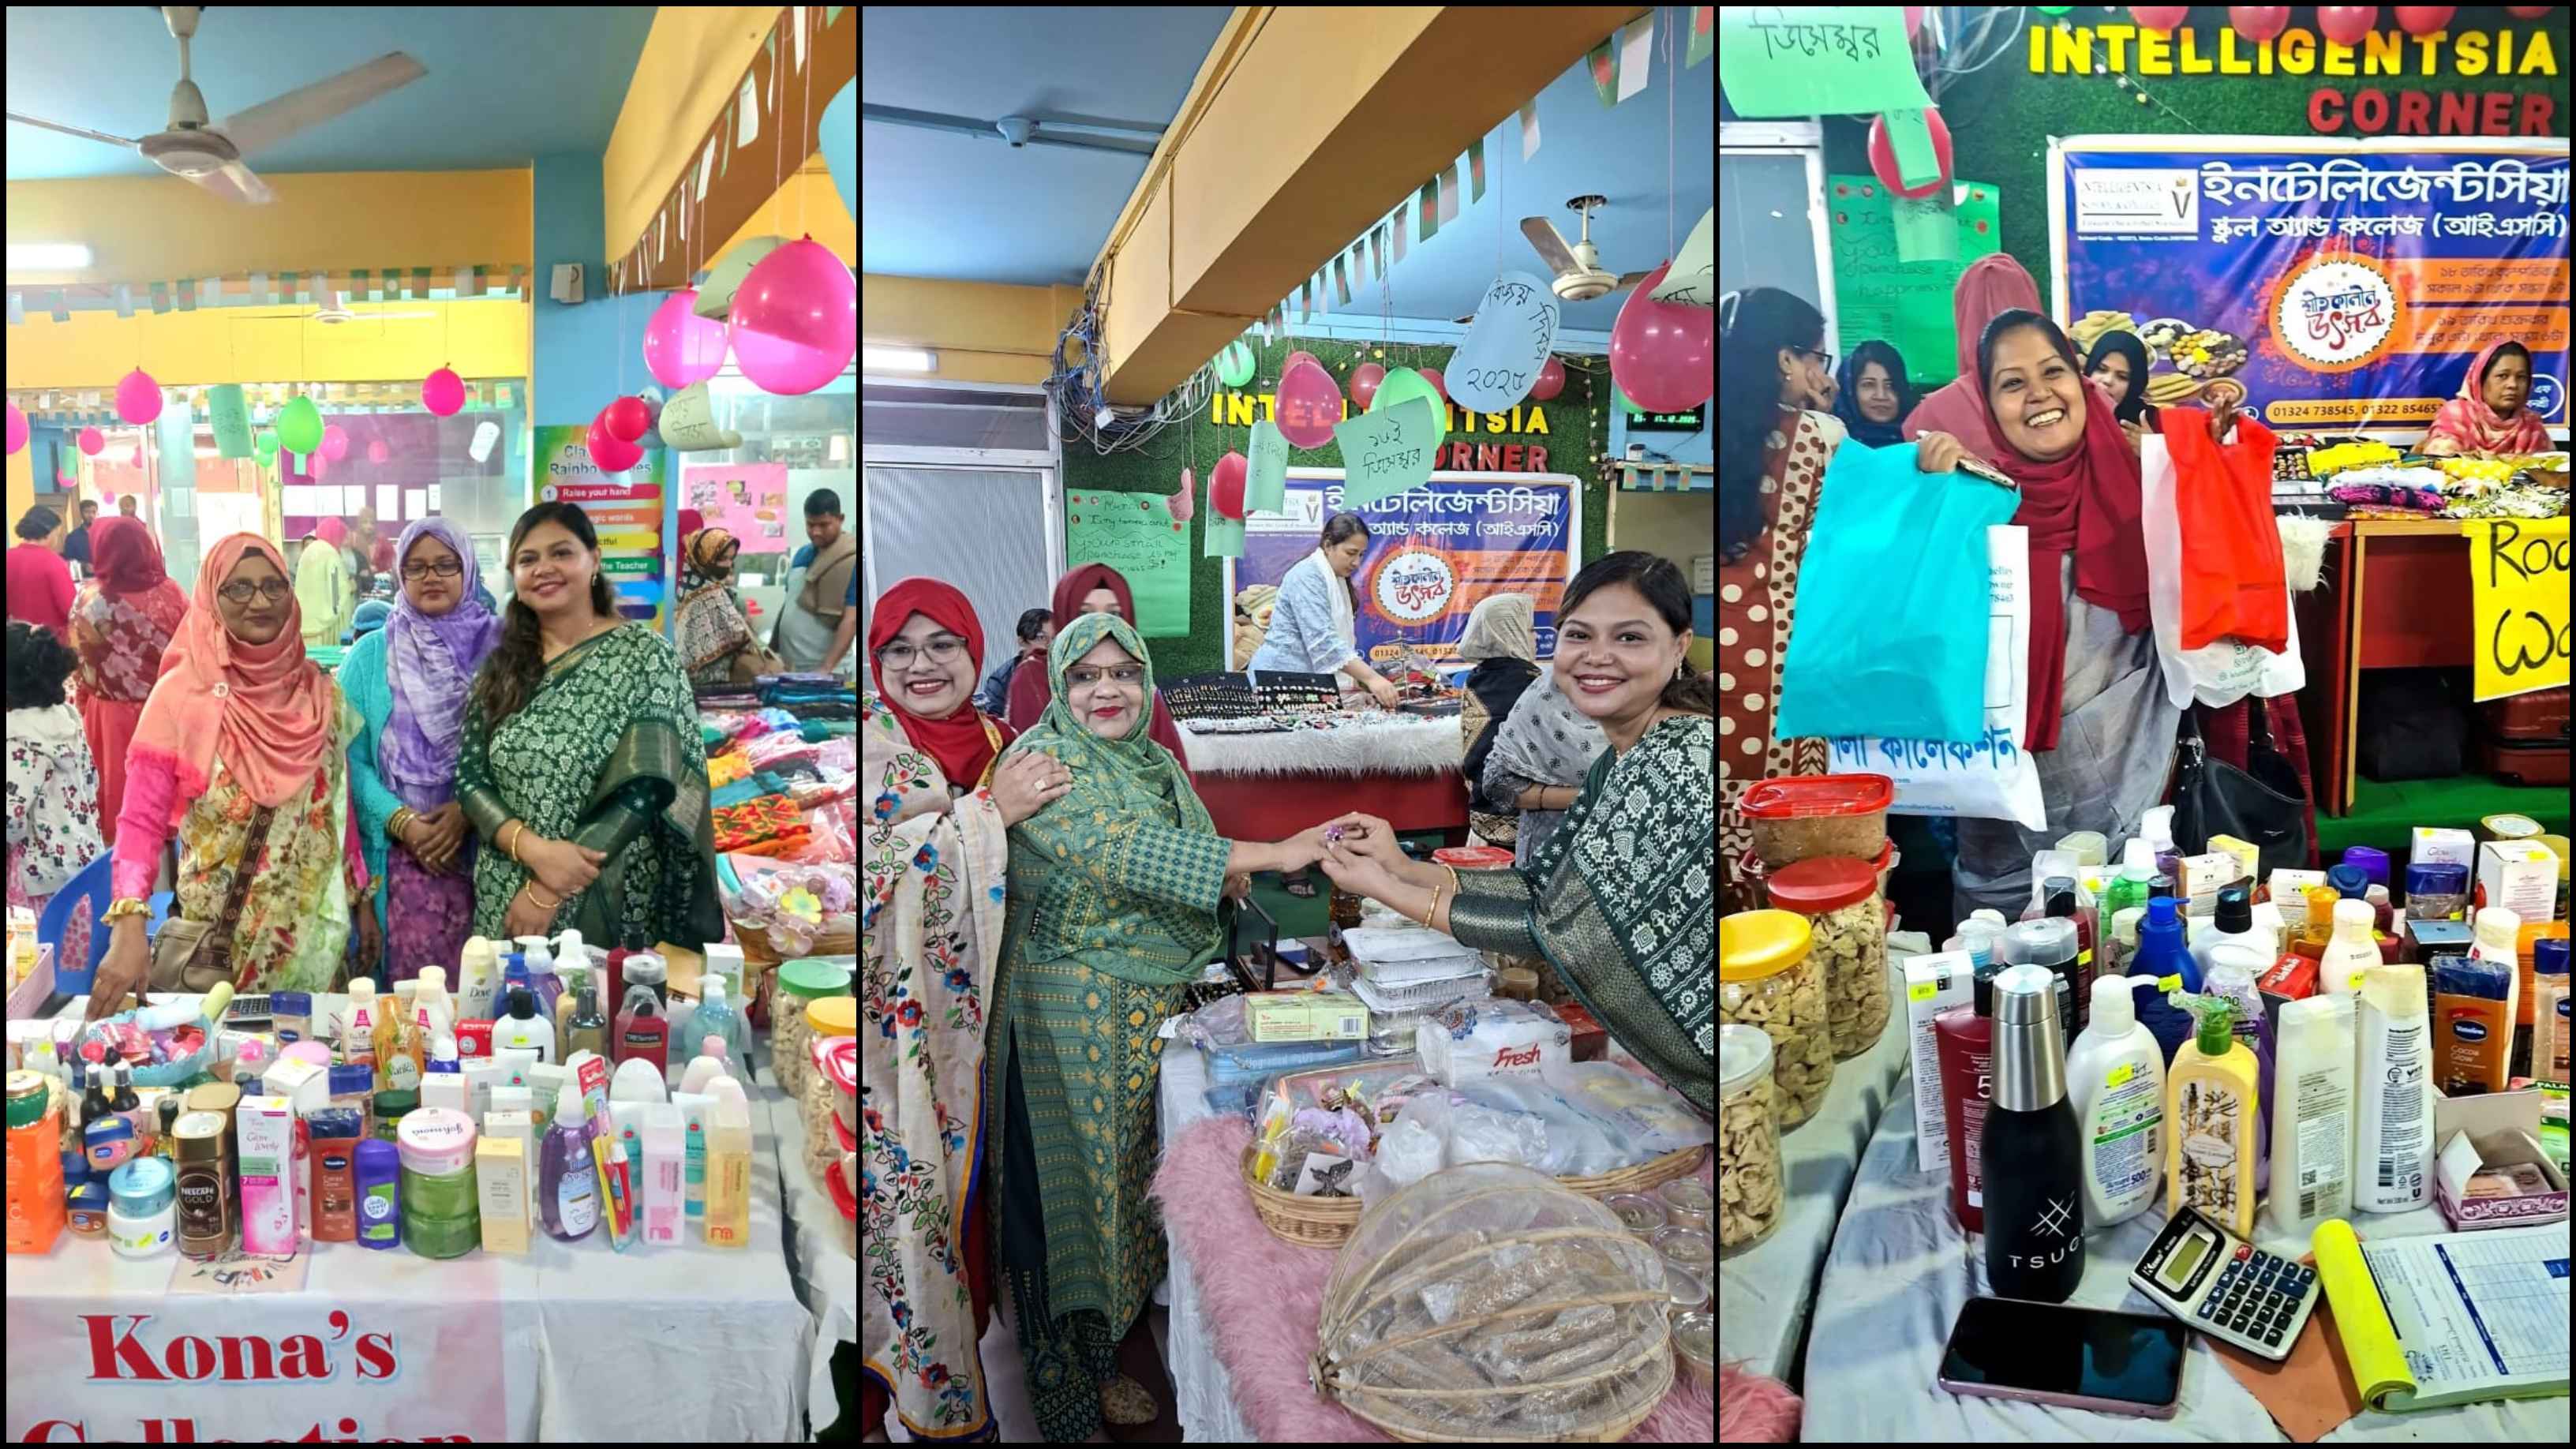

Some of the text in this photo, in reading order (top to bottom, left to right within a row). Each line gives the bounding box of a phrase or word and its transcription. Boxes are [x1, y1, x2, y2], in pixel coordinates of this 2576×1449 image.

[2029, 25, 2558, 76] INTELLIGENTSIA
[2308, 88, 2554, 136] CORNER
[2200, 159, 2569, 207] ইনটেলিজেন্টসিয়া
[2211, 215, 2258, 243] স্কুল
[2338, 216, 2425, 238] কলেজ
[2432, 211, 2567, 238] (আইএসসি)
[2305, 299, 2386, 350] উৎসব
[1466, 368, 1526, 398] ২০২৫
[2273, 406, 2309, 417] 01324
[2314, 404, 2359, 417] 738545,
[562, 488, 587, 498] Raise
[588, 488, 608, 499] your
[609, 487, 631, 497] hand
[1415, 521, 1470, 537] কলেজ
[616, 561, 649, 571] Teacher
[1395, 576, 1447, 611] উৎসব
[469, 987, 491, 998] Dove
[1493, 1042, 1541, 1068] Fresh
[2450, 1045, 2480, 1056] Cocoa
[2450, 1053, 2476, 1062] Glow
[2131, 1170, 2147, 1185] 500
[77, 1309, 398, 1381] Kona's
